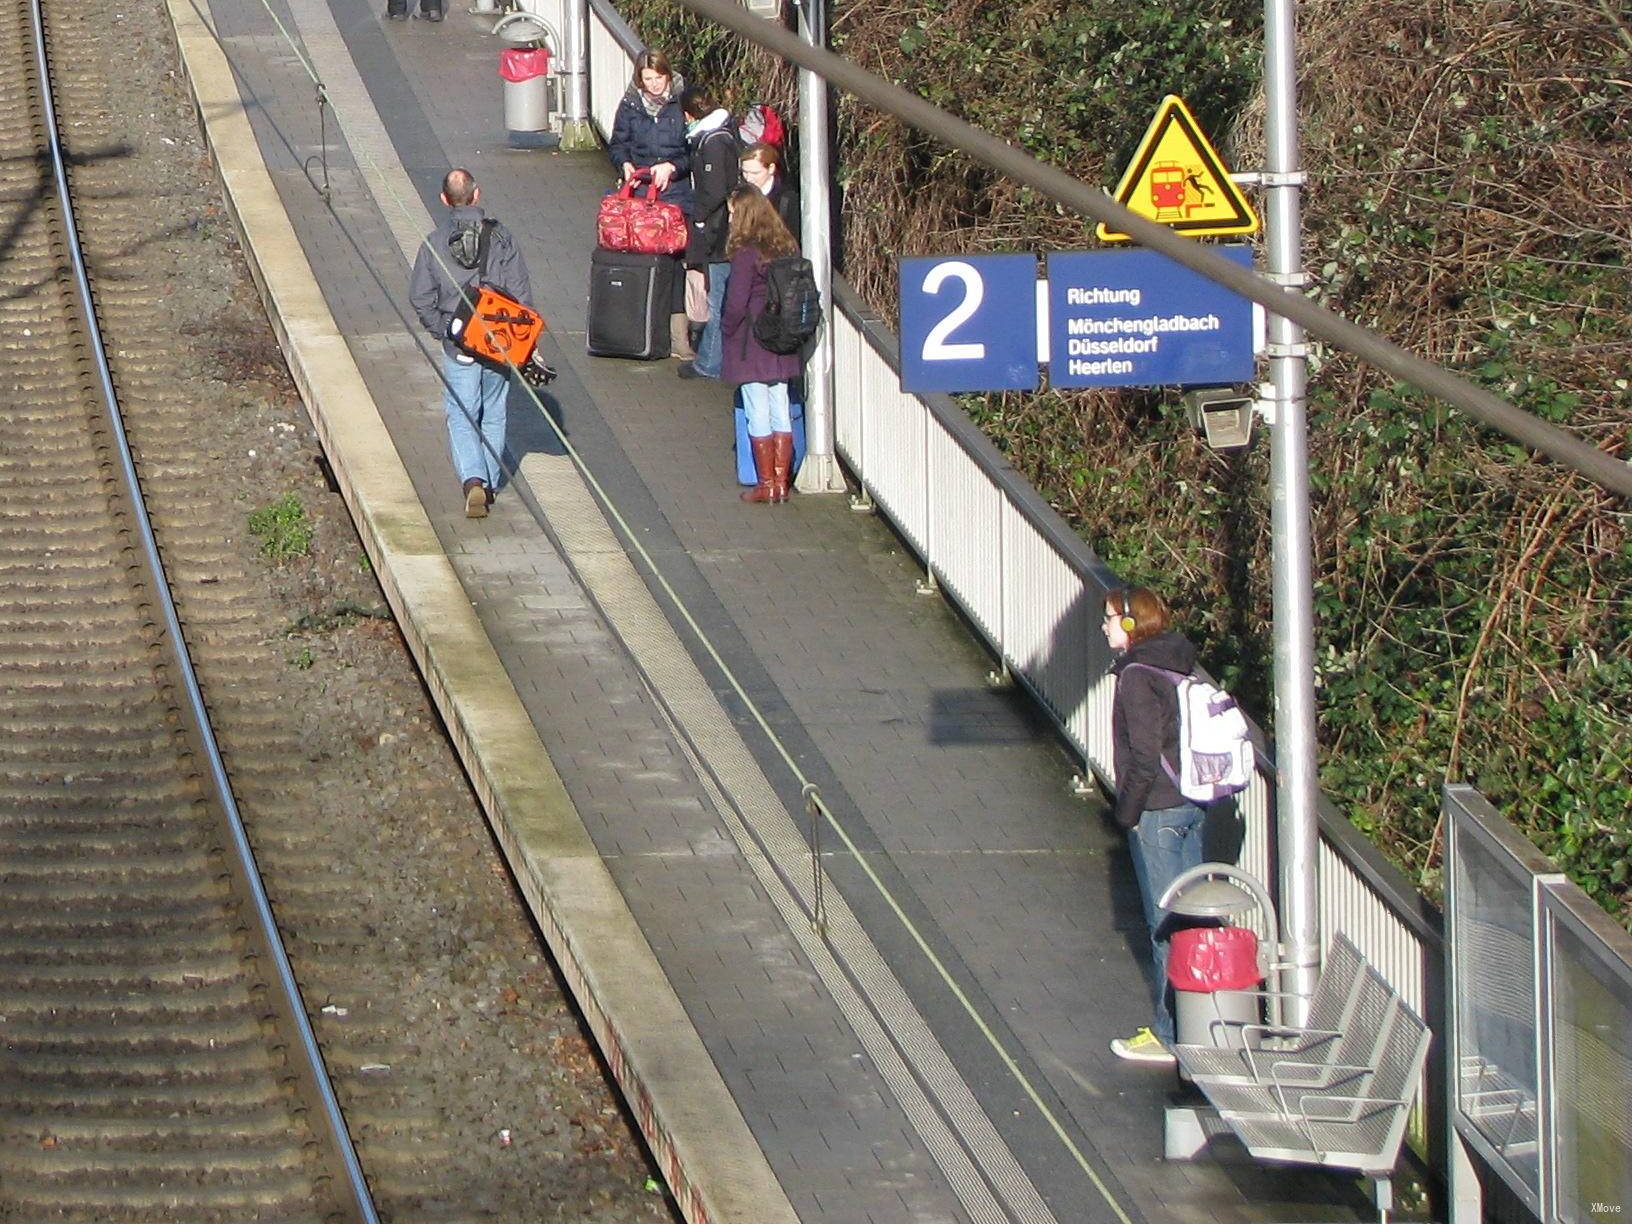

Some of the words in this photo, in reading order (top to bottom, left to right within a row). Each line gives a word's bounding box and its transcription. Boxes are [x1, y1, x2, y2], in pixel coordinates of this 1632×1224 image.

[1068, 287, 1141, 306] Richtung
[922, 261, 985, 361] 2
[1068, 314, 1219, 336] Mönchengladbach
[1069, 337, 1158, 356] Düsseldorf
[1069, 359, 1133, 376] Heerlen
